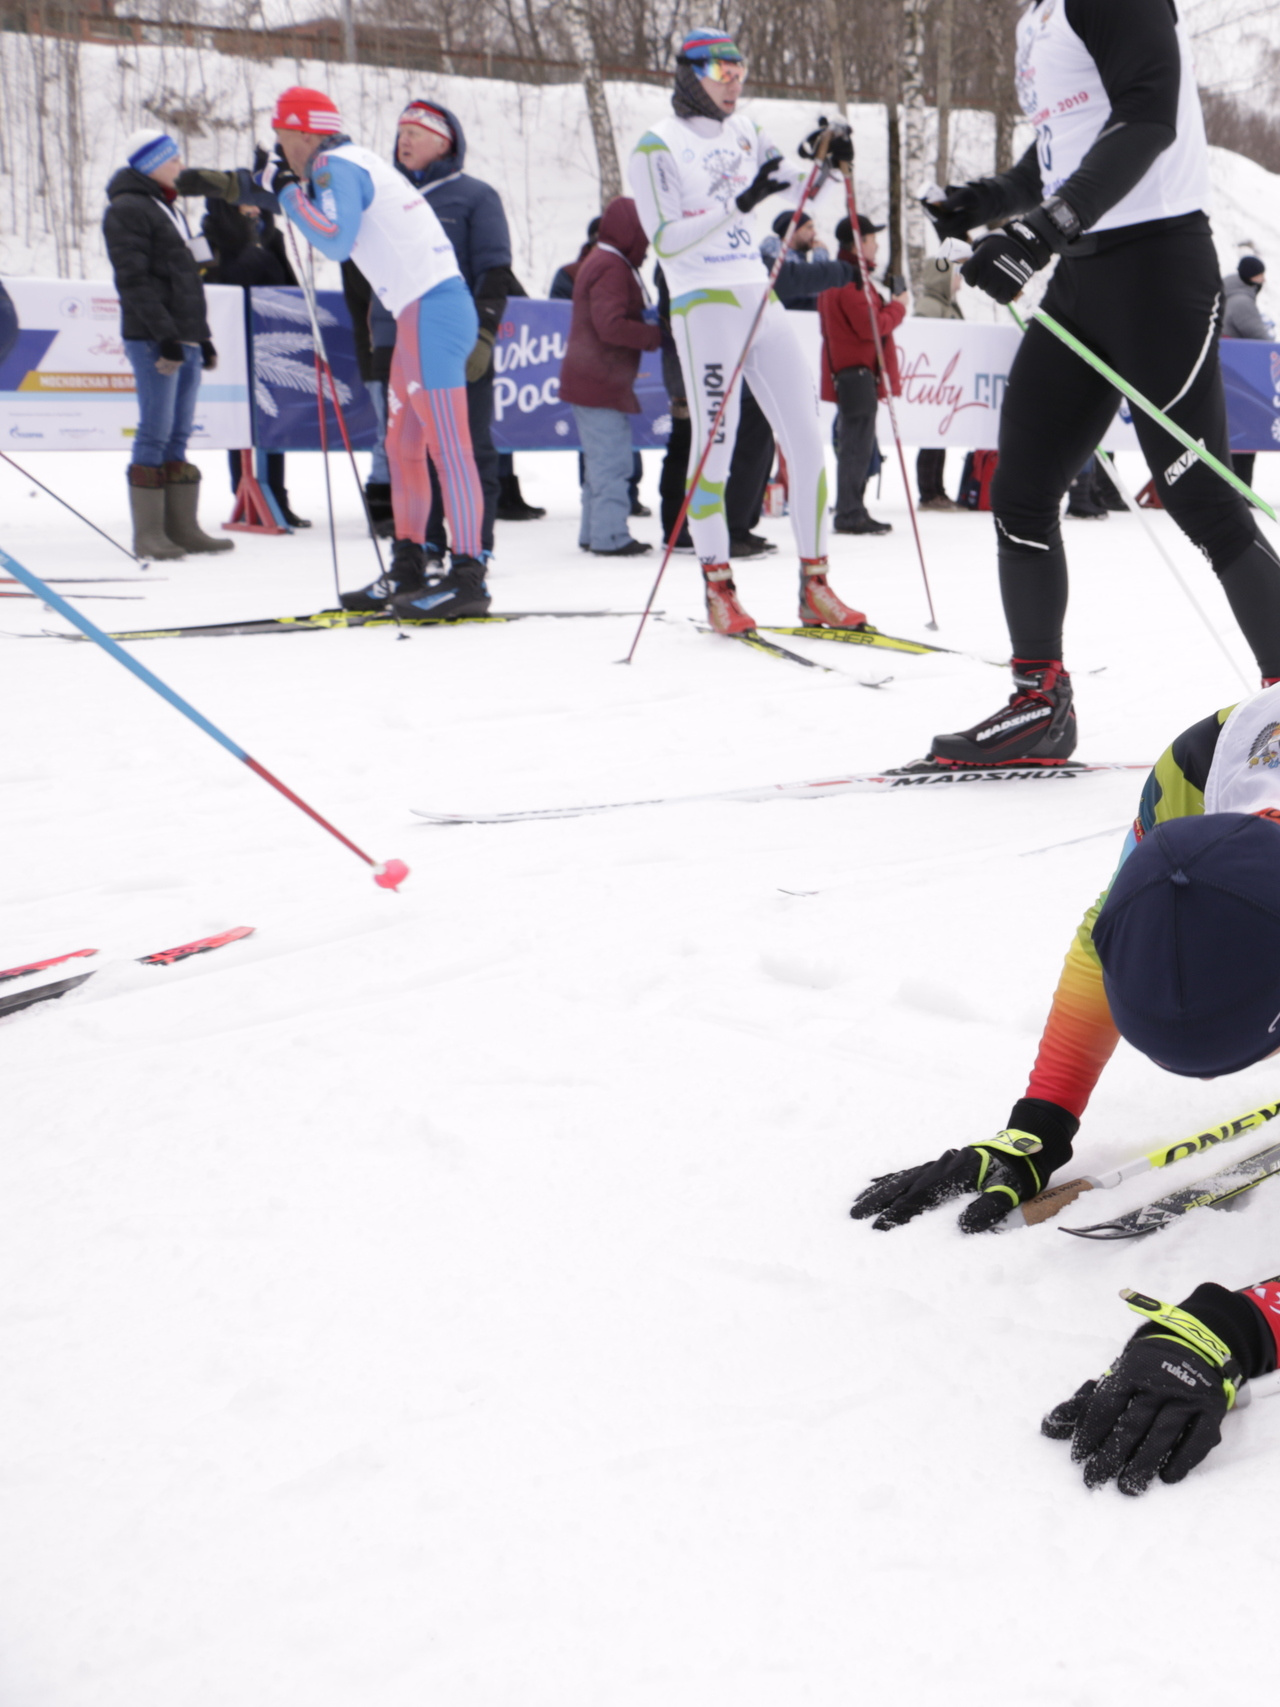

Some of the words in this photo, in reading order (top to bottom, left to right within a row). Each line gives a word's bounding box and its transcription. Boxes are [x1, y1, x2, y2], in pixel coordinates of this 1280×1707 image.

[1057, 91, 1089, 112] 2019
[976, 707, 1051, 741] MADSHUS
[892, 769, 1077, 787] MADSHUS
[1161, 1360, 1197, 1387] rukka
[1181, 1361, 1196, 1376] Wind
